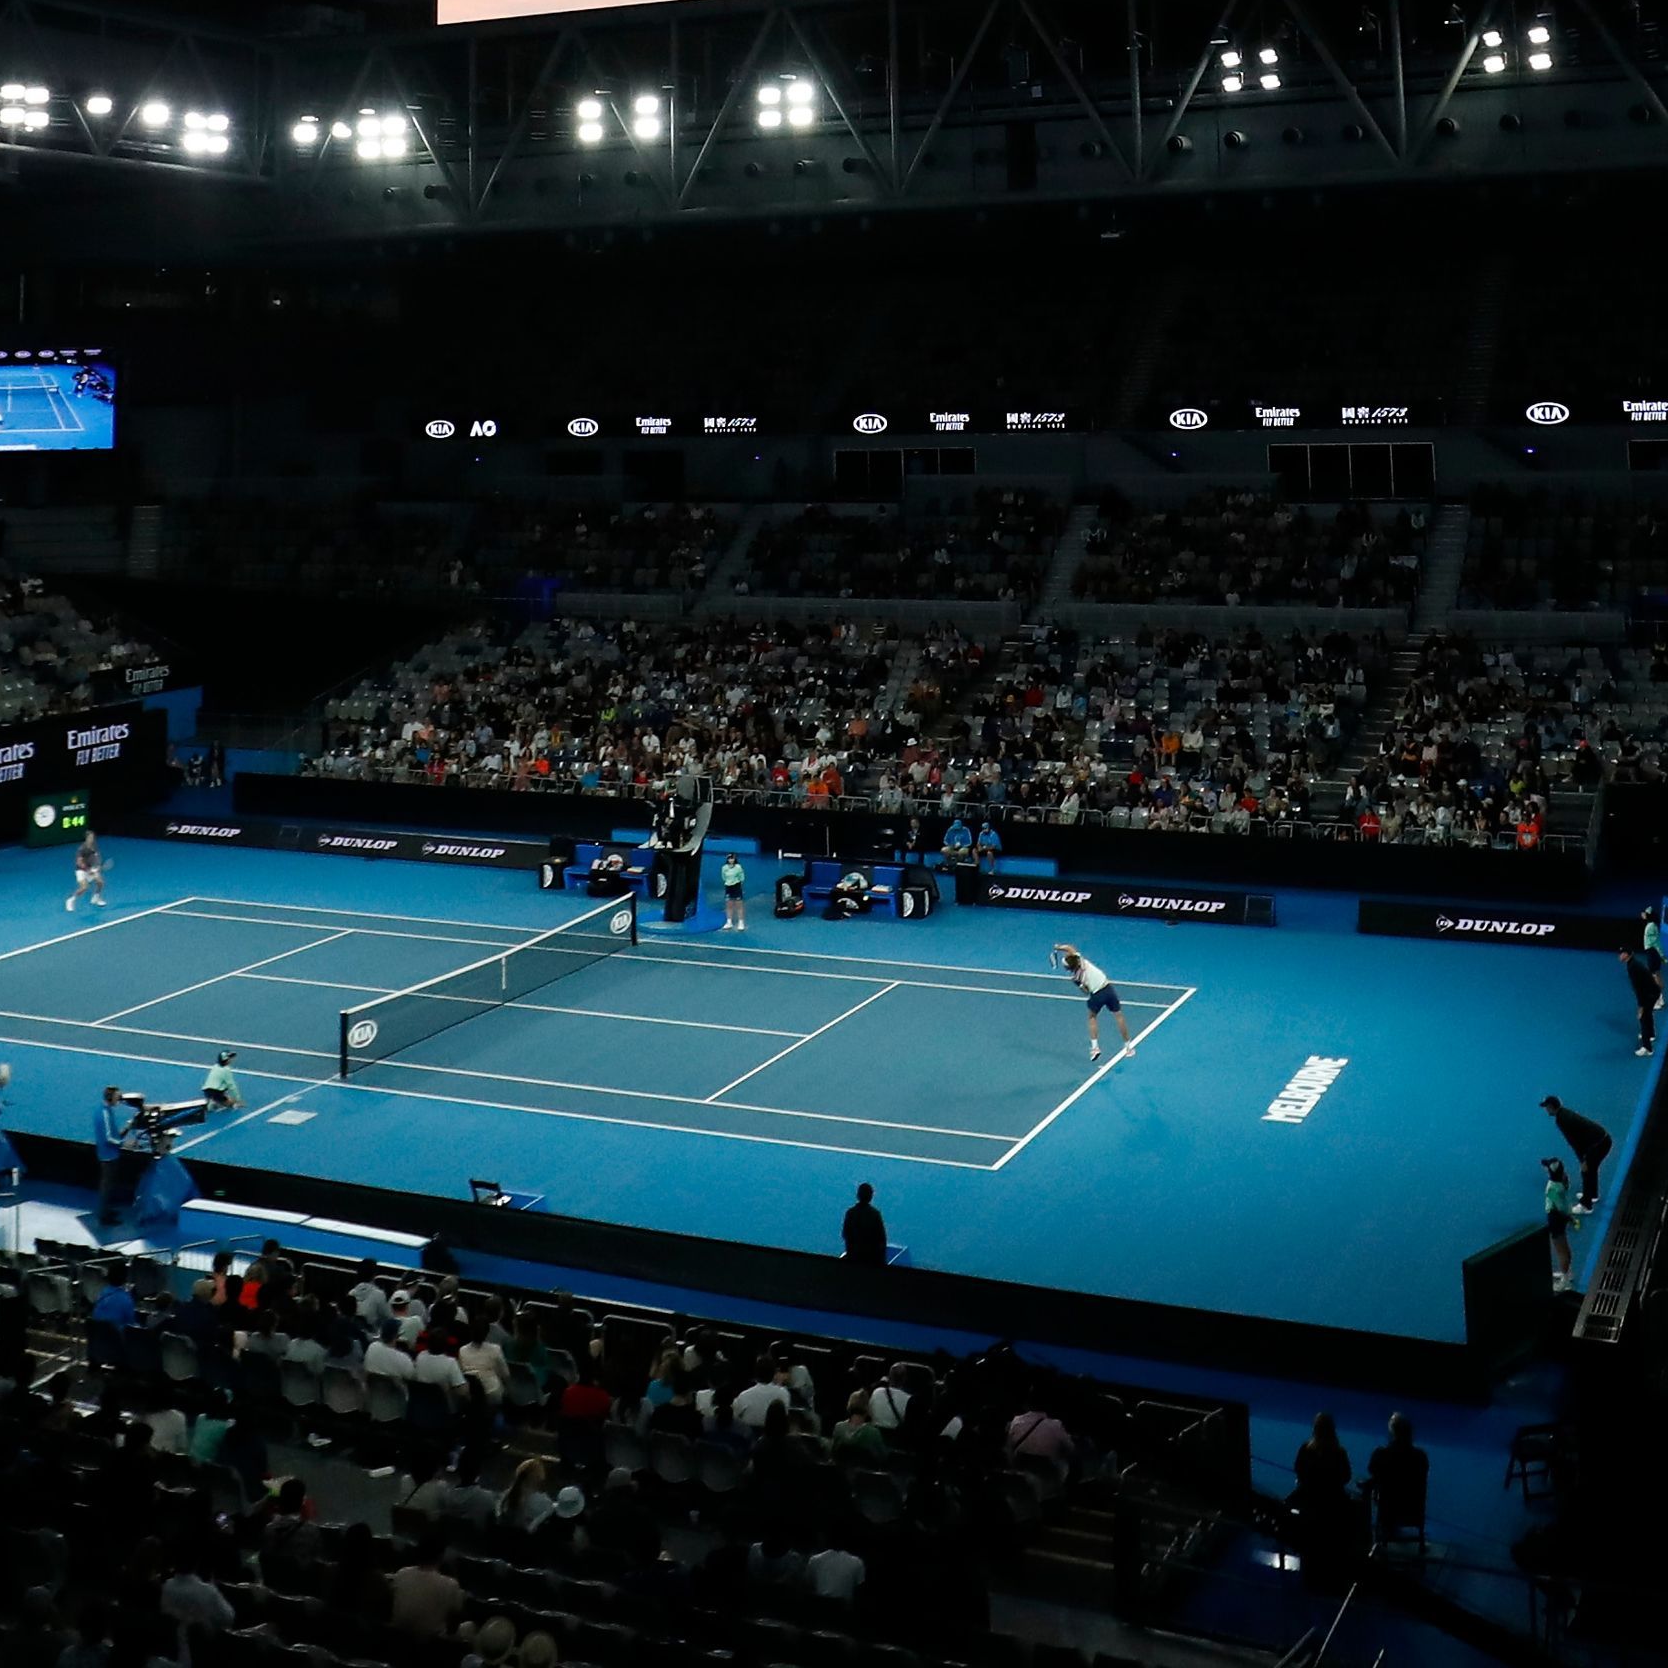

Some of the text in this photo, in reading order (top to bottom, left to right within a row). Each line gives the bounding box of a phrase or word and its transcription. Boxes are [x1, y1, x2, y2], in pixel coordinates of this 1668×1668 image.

[929, 412, 970, 423] Emirates
[1255, 406, 1301, 418] Emirates
[635, 417, 672, 427] Emirates
[125, 665, 170, 683] Emirates
[66, 721, 130, 750] Emirates
[178, 825, 242, 838] DUNLOP
[329, 836, 399, 851] DUNLOP
[434, 844, 507, 859] DUNLOP
[1004, 886, 1093, 905] DUNLOP
[1134, 896, 1226, 914] DUNLOP
[1454, 918, 1556, 938] DUNLOP
[1260, 1054, 1349, 1124] MELBOURNE
